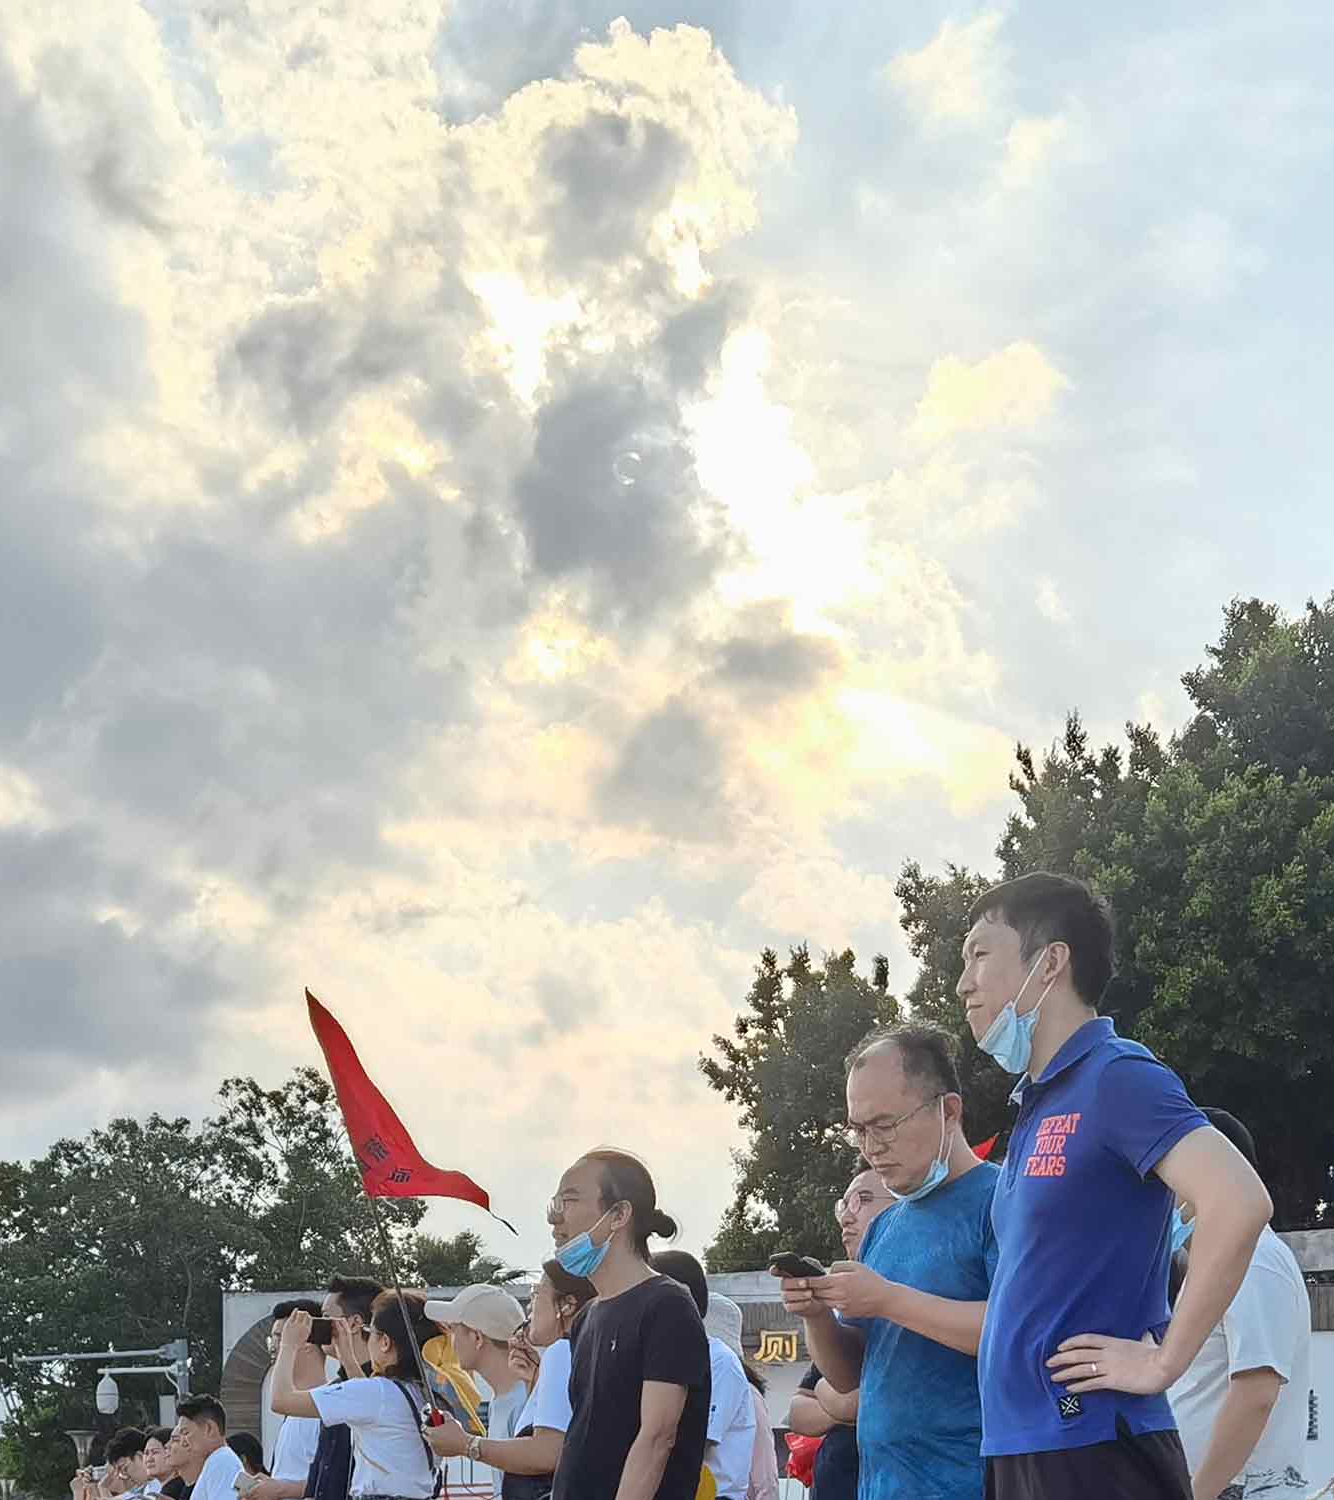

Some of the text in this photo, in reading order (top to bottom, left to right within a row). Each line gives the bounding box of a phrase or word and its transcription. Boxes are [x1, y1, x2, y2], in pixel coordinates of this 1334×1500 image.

[1035, 1112, 1082, 1137] DEFEAT
[1032, 1134, 1067, 1156] YOUR
[1023, 1155, 1067, 1177] FEARS
[753, 1330, 797, 1362] 厕
